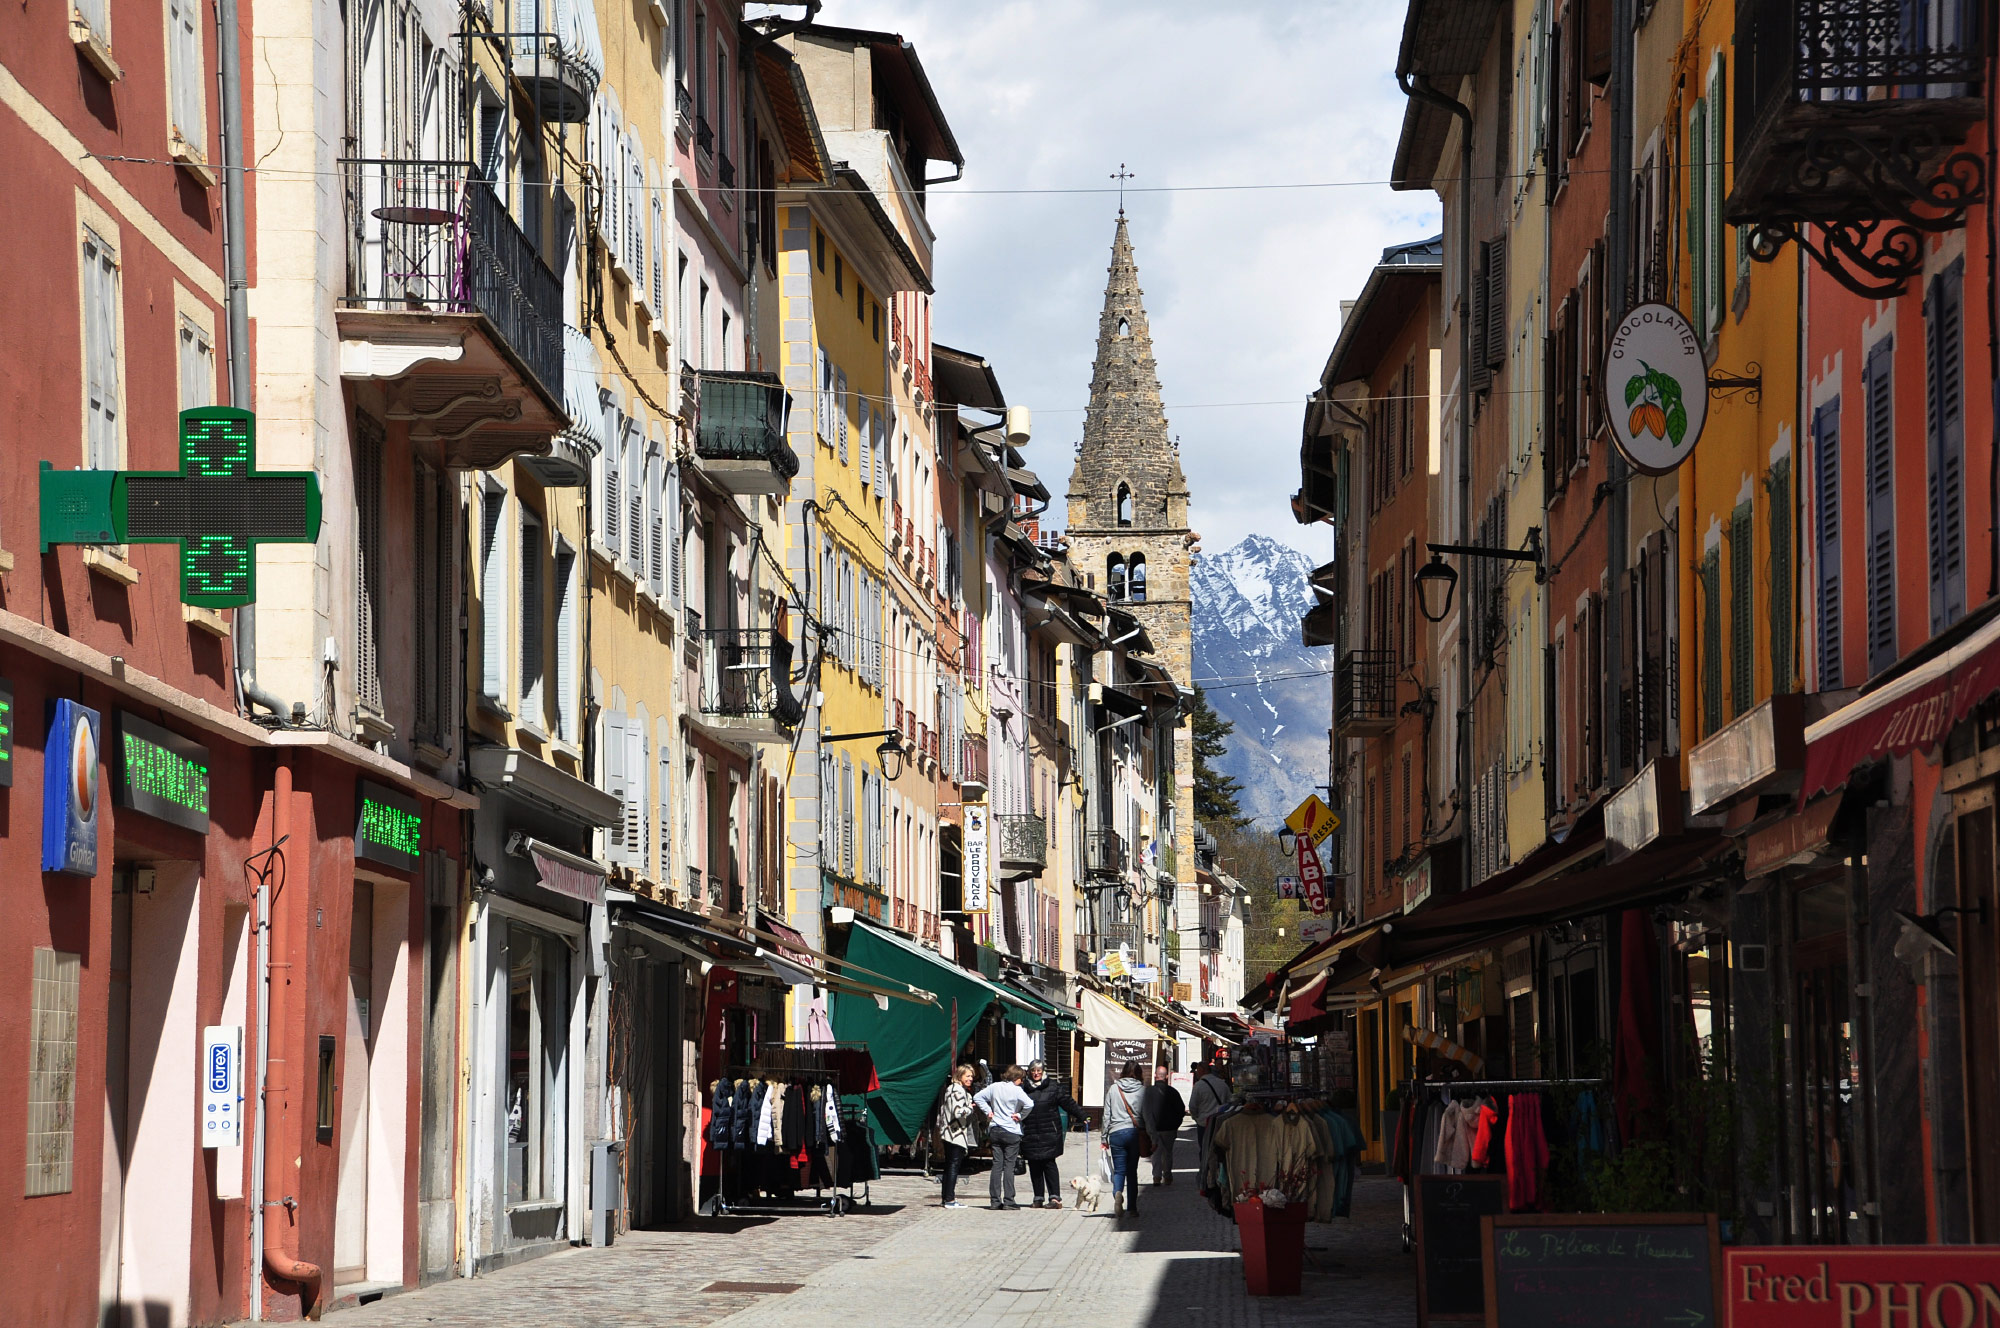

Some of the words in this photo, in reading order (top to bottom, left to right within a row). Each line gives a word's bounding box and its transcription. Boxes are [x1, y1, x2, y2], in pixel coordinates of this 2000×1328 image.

[1613, 312, 1695, 359] CHOCOLATIER
[125, 733, 208, 813] PHARMACIE
[362, 798, 421, 856] PHARMACIE
[70, 841, 95, 869] Giphar
[1299, 835, 1324, 910] TABAC
[215, 1046, 229, 1088] durex
[1538, 1231, 1601, 1262] Délices
[1608, 1232, 1626, 1255] de
[1740, 1261, 1831, 1303] Fred
